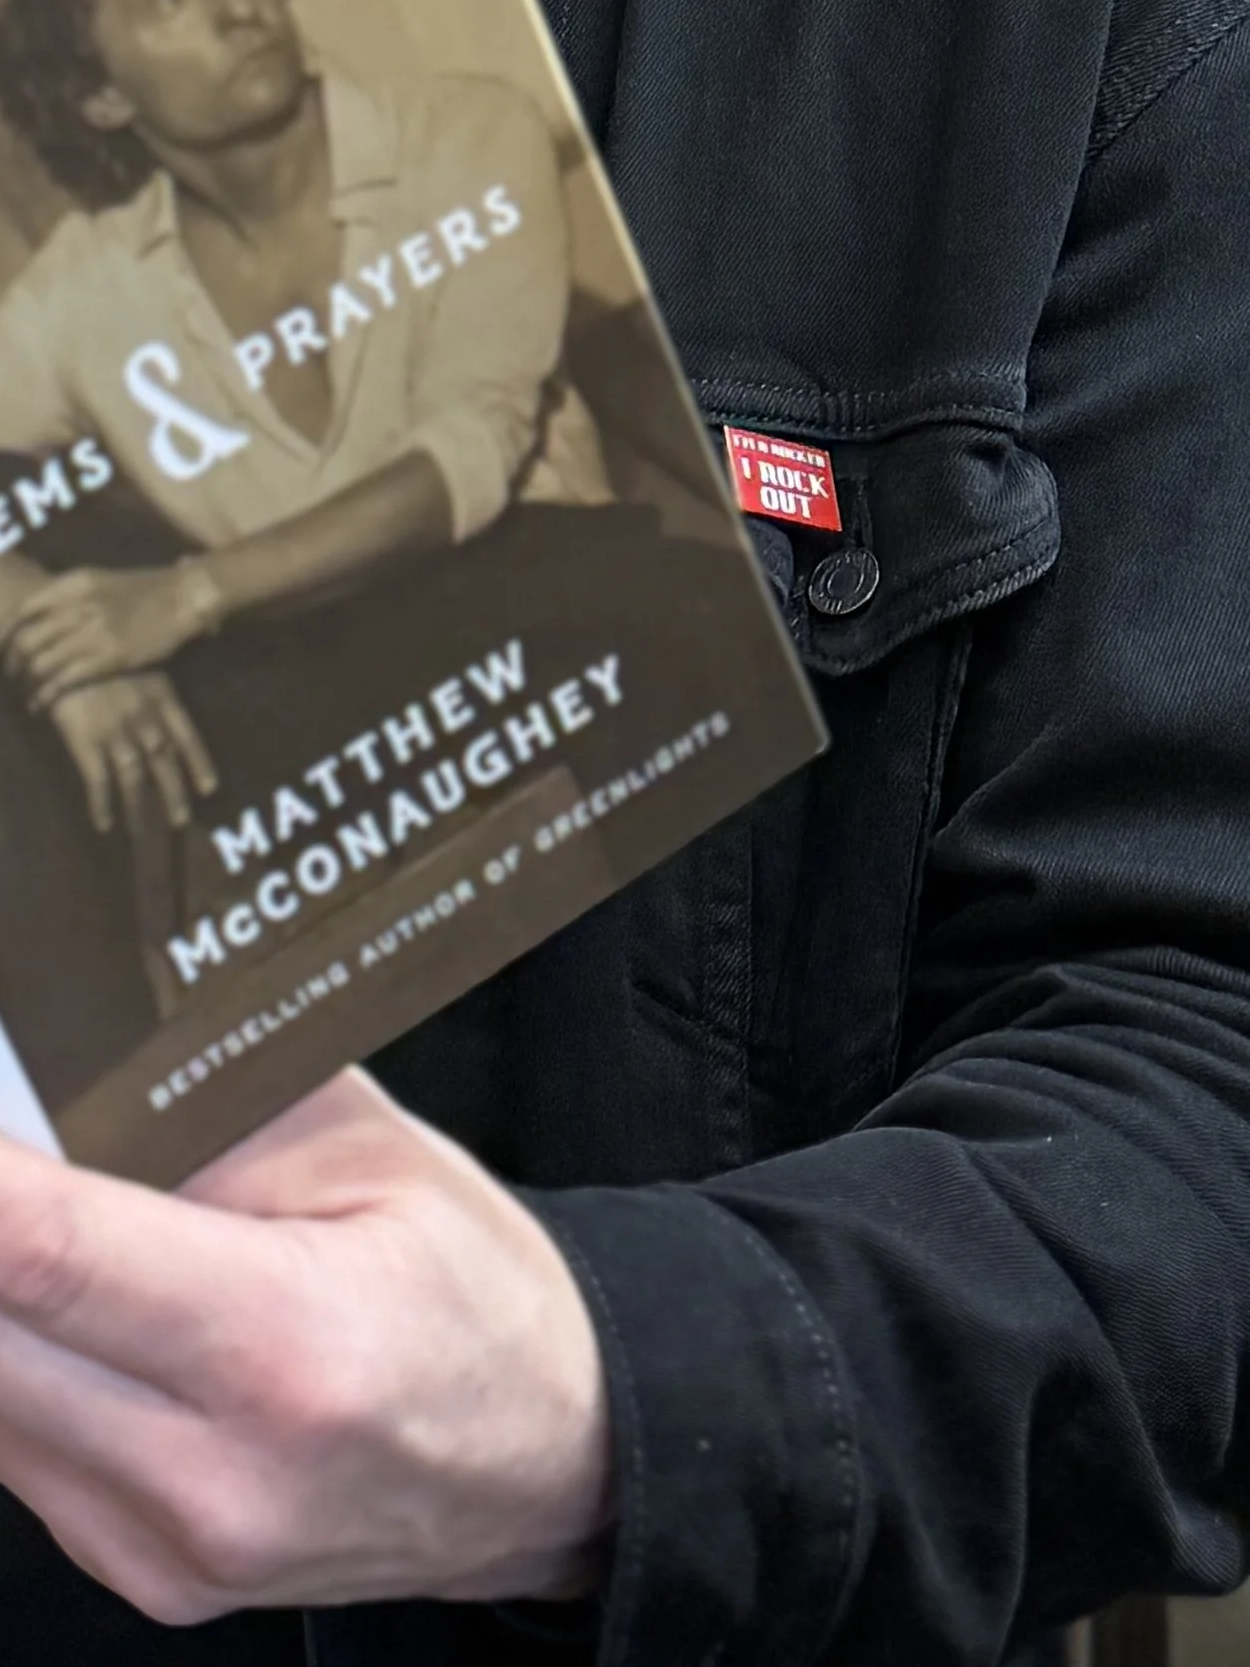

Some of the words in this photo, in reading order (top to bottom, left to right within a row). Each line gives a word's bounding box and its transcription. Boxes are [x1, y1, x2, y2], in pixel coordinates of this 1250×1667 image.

[123, 340, 251, 482] &
[233, 185, 522, 391] PRAYERS
[740, 456, 751, 479] I
[758, 461, 828, 499] ROCK
[760, 487, 812, 519] OUT
[211, 638, 527, 874] MATTHEW
[148, 961, 350, 1112] BESTSELLING
[358, 879, 477, 969] AUTHOR
[483, 845, 522, 886] OF
[534, 710, 731, 852] GREENLIGHTS
